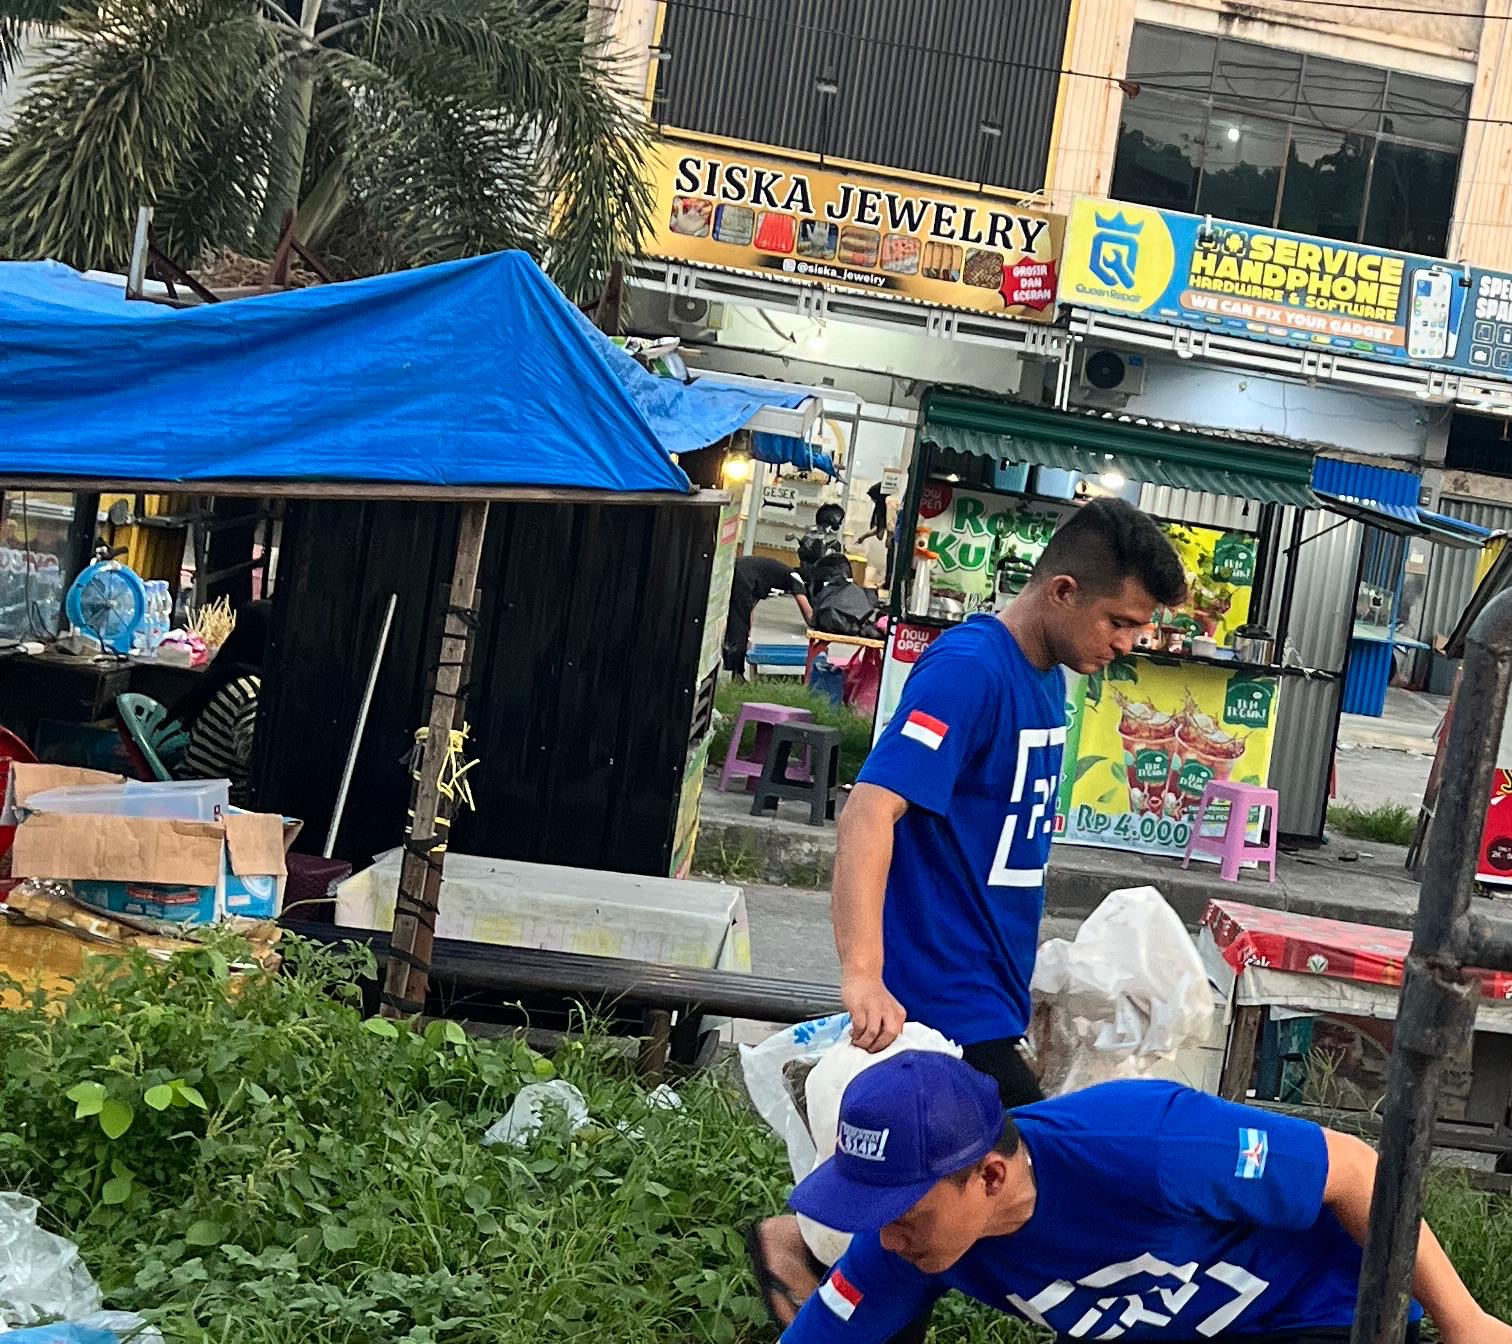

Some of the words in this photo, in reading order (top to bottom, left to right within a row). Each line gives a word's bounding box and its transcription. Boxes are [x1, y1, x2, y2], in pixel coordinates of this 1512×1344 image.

[675, 157, 816, 214] SISKA
[827, 185, 1048, 254] JEWELRY
[1020, 276, 1042, 289] DAN
[1190, 251, 1400, 311] HANDPHONE
[1249, 233, 1405, 286] SERVICE
[1189, 274, 1284, 303] HARDWARE
[1288, 290, 1300, 306] &
[1305, 295, 1398, 323] SOFTWARE
[1190, 294, 1218, 311] WE
[1220, 298, 1252, 317] CAN
[1255, 303, 1282, 322] FIX
[1285, 308, 1328, 329] YOUR
[1330, 315, 1395, 343] GADGET
[763, 486, 796, 500] GESER
[1077, 804, 1109, 833] Rp
[1114, 814, 1191, 846] 4.000
